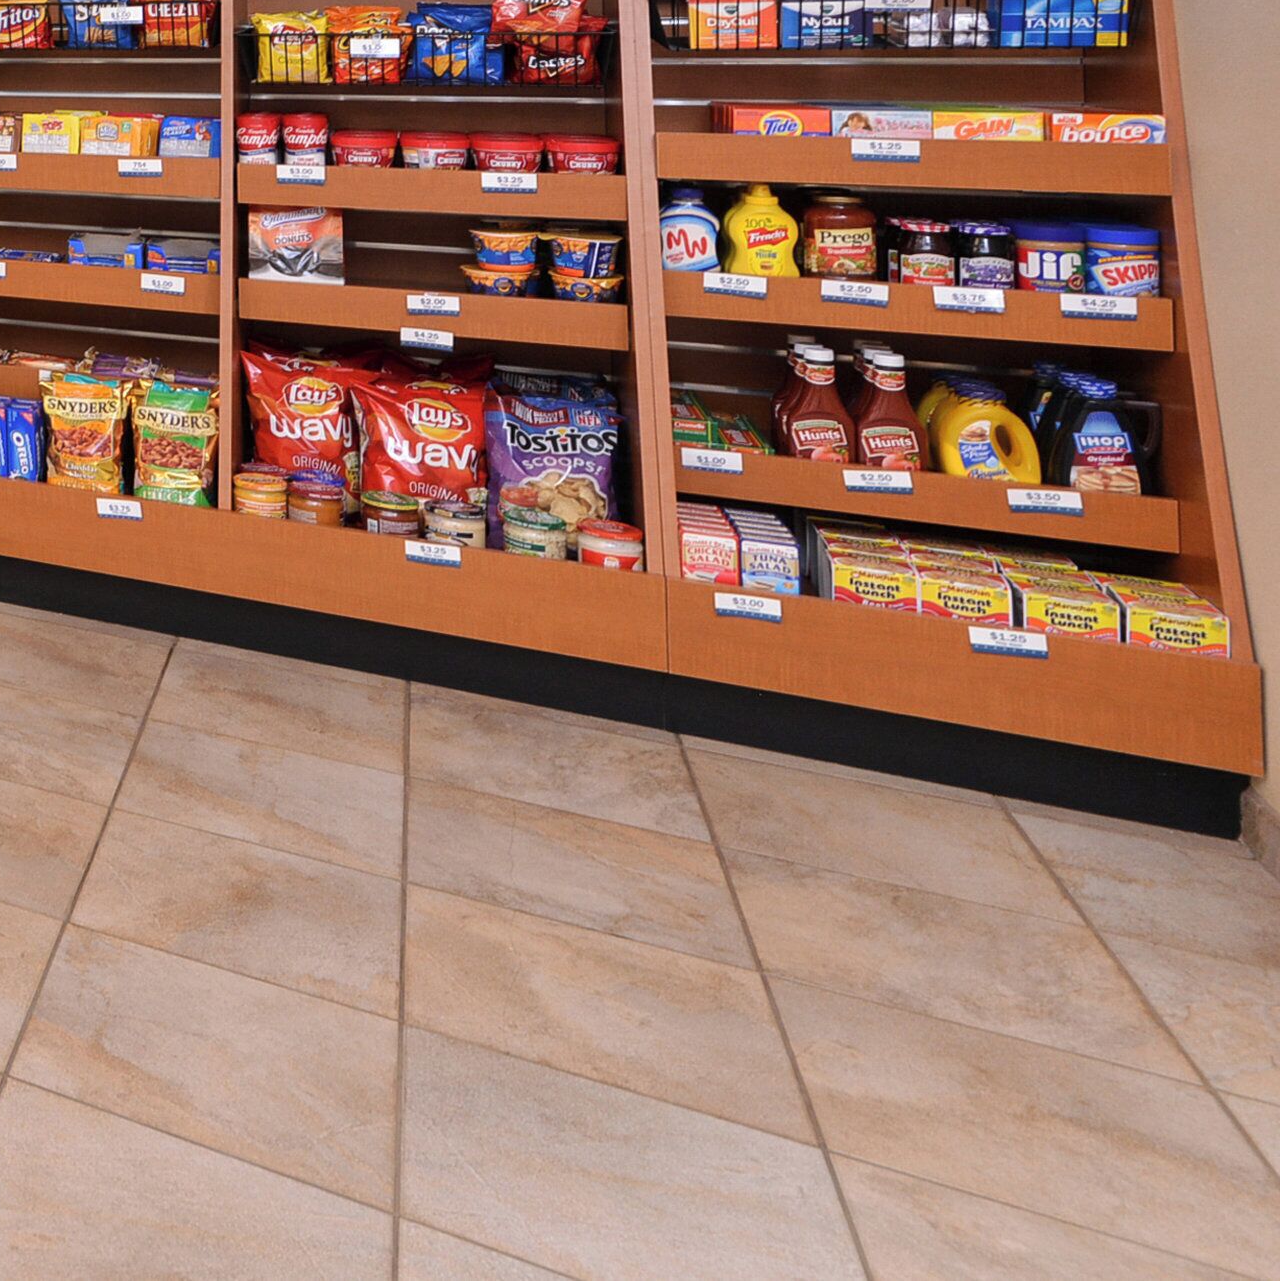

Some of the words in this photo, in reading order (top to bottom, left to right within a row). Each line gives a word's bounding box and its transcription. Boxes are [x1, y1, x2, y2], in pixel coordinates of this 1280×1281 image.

[706, 16, 759, 28] DayQuil
[801, 16, 850, 29] NyQuil
[1024, 16, 1103, 30] TAMPAX
[528, 54, 586, 70] Doritos
[763, 118, 798, 135] Tide
[953, 117, 1015, 139] GAIN
[1061, 123, 1150, 143] bounce
[869, 141, 902, 150] $1.25
[496, 175, 524, 184] $3.25
[273, 232, 313, 245] DONUTS
[819, 230, 871, 247] Prego
[1018, 251, 1083, 281] Jif
[719, 276, 750, 286] $2.50
[839, 285, 872, 294] $2.50
[420, 298, 446, 307] $2.00
[952, 293, 987, 302] $3.75
[1081, 298, 1118, 308] $4.25
[289, 386, 337, 406] Lay's
[47, 397, 118, 414] SNYDER'S
[137, 409, 211, 429] SNYDER'S
[412, 403, 464, 428] Lay's
[269, 413, 353, 449] wavy
[799, 429, 841, 444] Hunt's
[506, 421, 618, 455] TOSTITOS
[869, 436, 912, 450] Hunt's
[1079, 435, 1125, 448] IHOP
[10, 430, 29, 475] OREO
[387, 436, 479, 482] wavy
[1087, 454, 1125, 464] Original
[522, 456, 606, 474] SCOOPS!
[696, 456, 726, 465] $1.00
[860, 473, 893, 482] $2.50
[1026, 492, 1061, 502] $3.50
[419, 545, 447, 556] $3.25
[687, 546, 733, 560] CHICKEN
[689, 555, 731, 568] SALAD
[752, 554, 787, 565] TUNA
[749, 562, 791, 575] SALAD
[858, 571, 899, 582] Maruchan
[849, 577, 901, 593] Instant
[948, 585, 991, 596] Maruchan
[854, 587, 896, 600] Lunch
[938, 591, 992, 608] Instant
[732, 596, 765, 608] $3.00
[943, 601, 988, 615] Lunch
[1053, 602, 1097, 613] Maruchan
[1044, 608, 1099, 624] Instant
[1049, 618, 1094, 631] Lunch
[1158, 617, 1205, 629] Maruchan
[990, 631, 1027, 644] $1.25
[1149, 623, 1208, 640] Instant
[1155, 633, 1202, 647] Lunch
